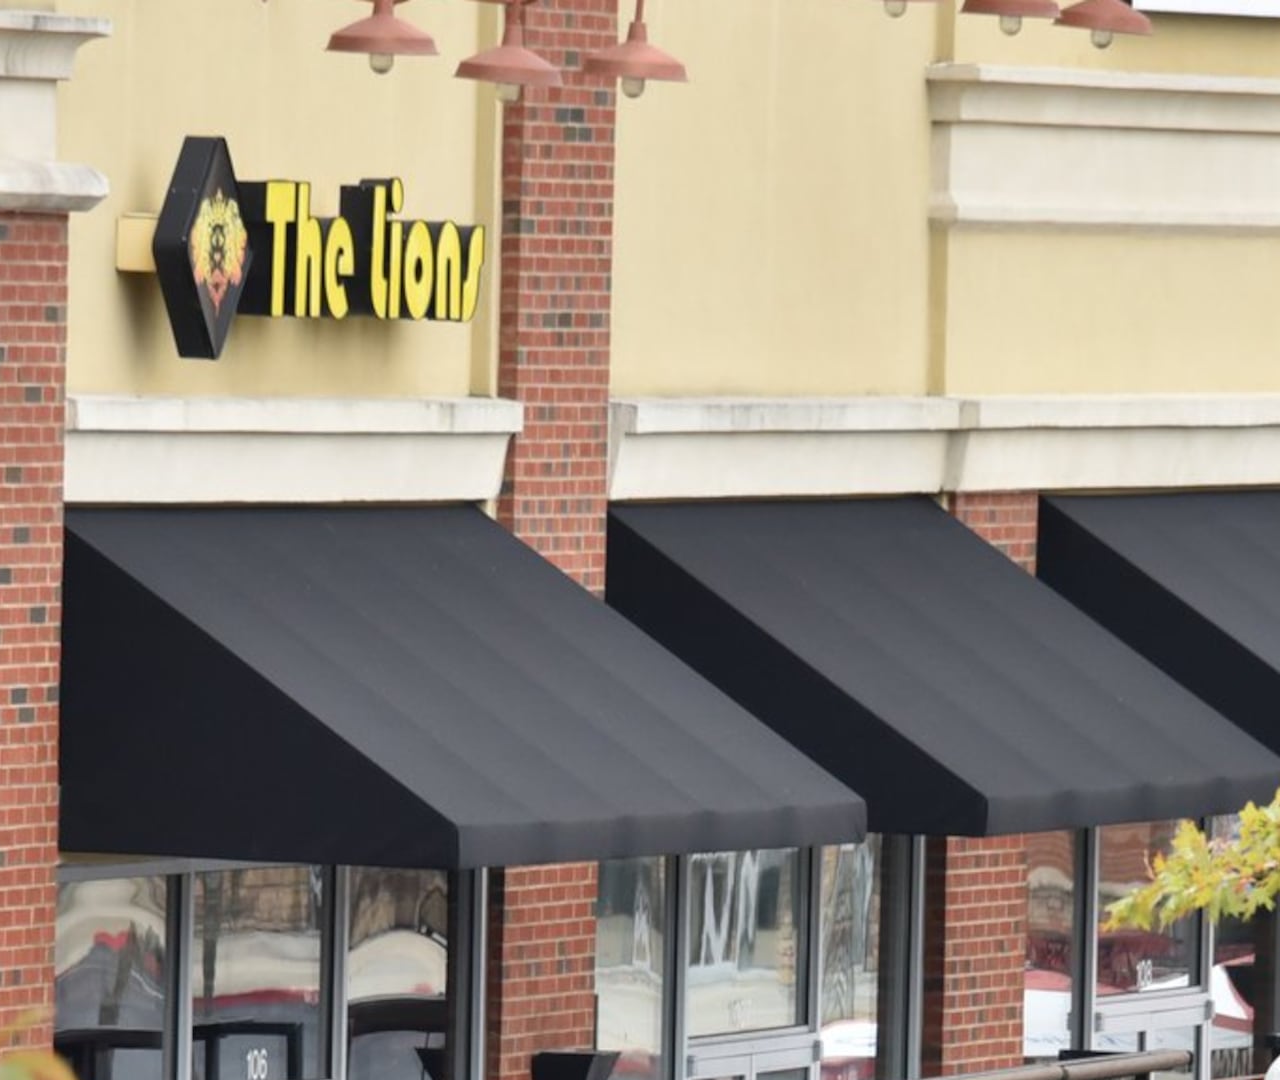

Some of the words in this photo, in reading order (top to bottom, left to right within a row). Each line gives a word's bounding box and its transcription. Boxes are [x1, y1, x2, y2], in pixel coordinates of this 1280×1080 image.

[265, 180, 355, 320] The
[370, 177, 486, 323] Lions
[246, 1047, 268, 1080] 106
